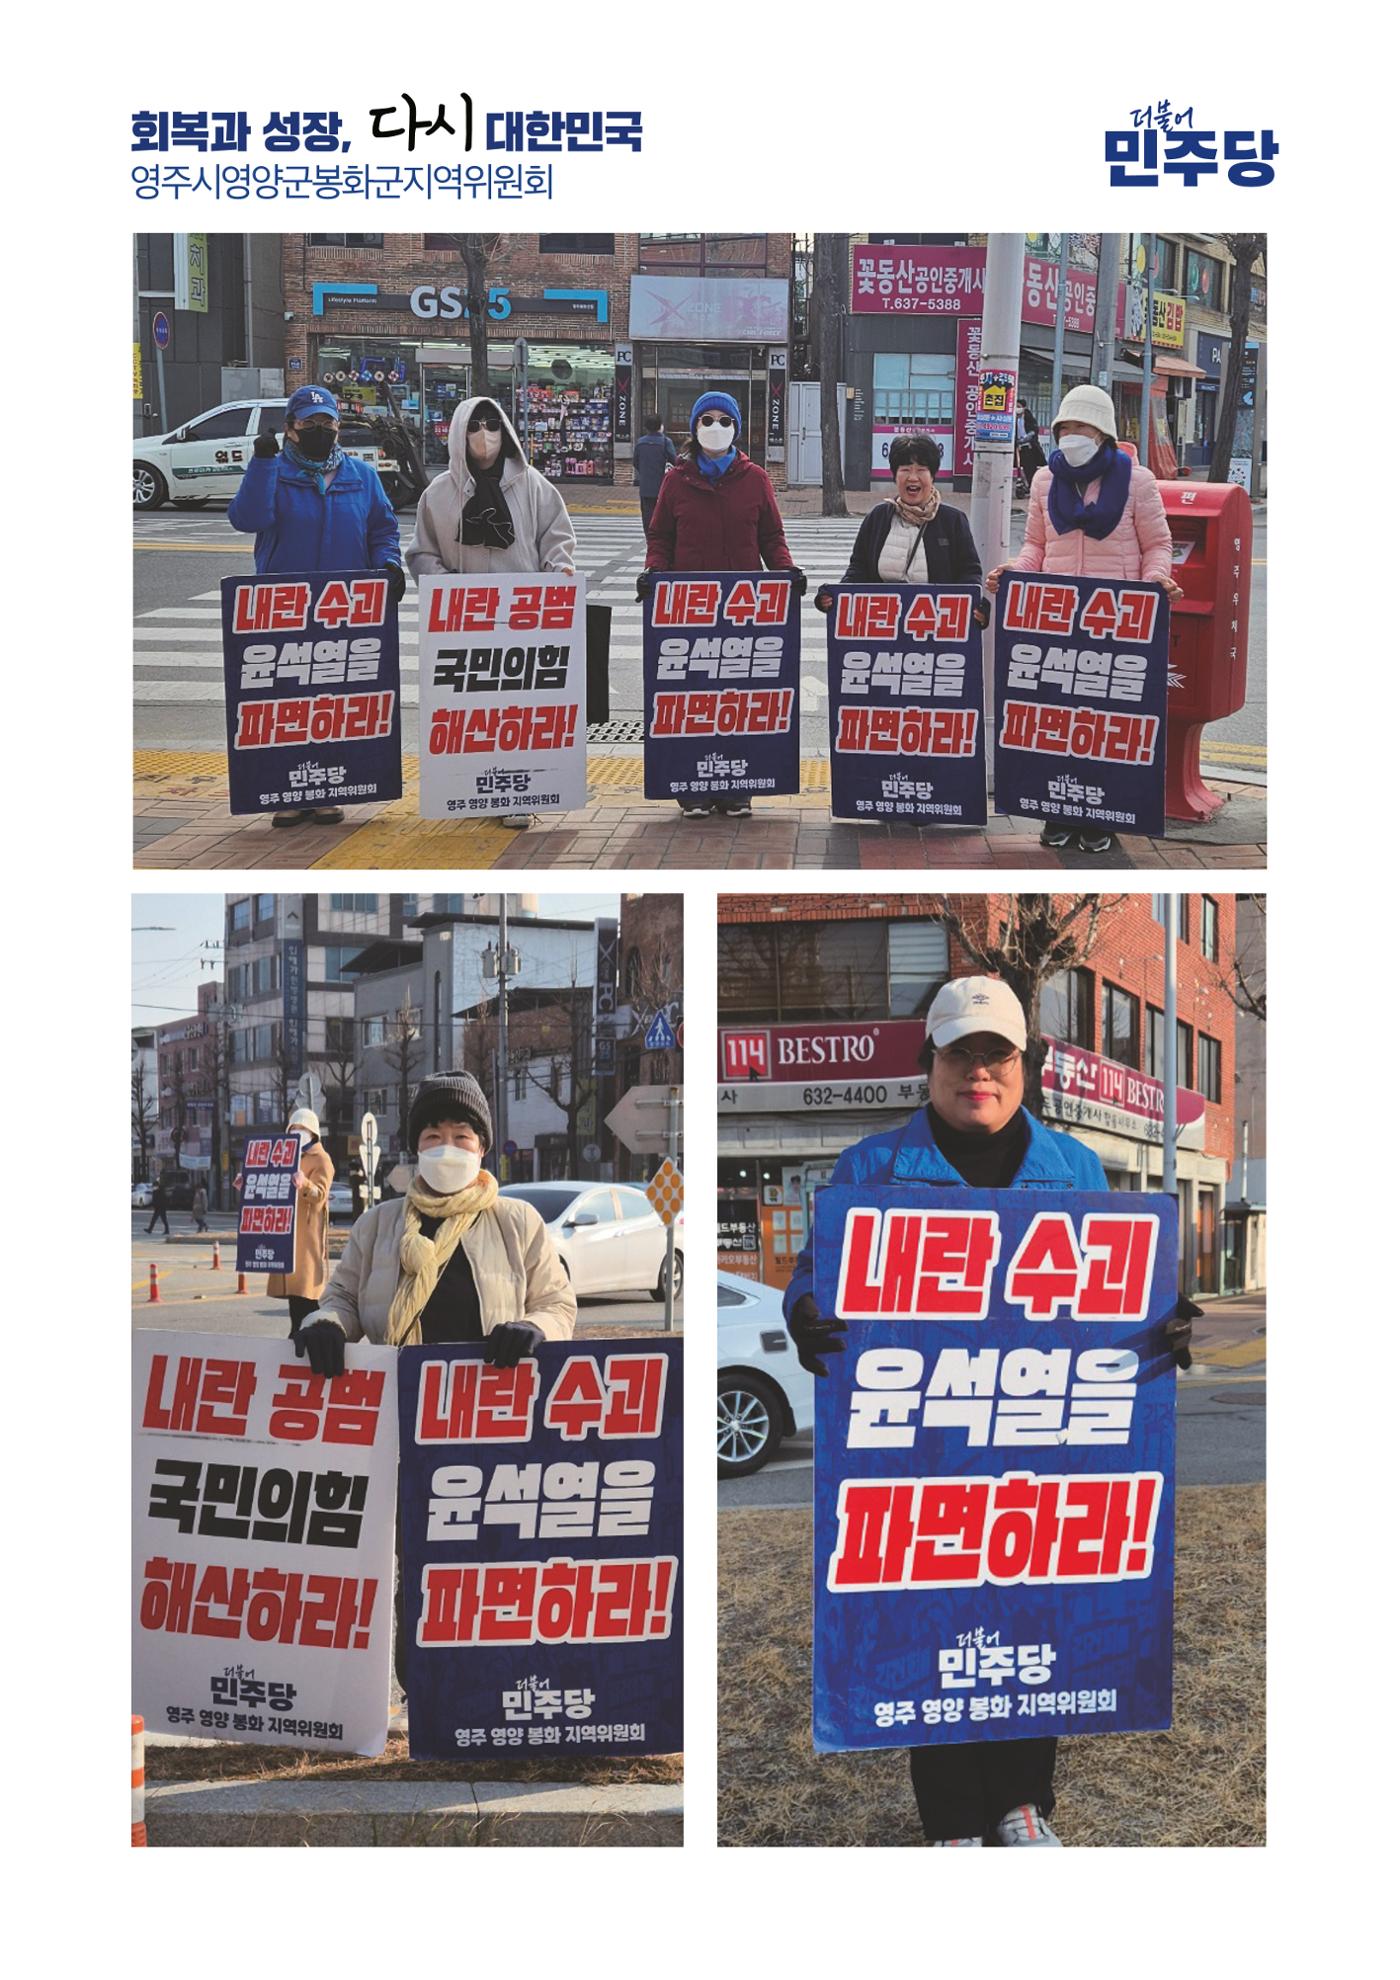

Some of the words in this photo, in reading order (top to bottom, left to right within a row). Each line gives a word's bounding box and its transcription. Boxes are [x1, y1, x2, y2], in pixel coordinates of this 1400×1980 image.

[410, 285, 512, 320] GS5
[882, 298, 961, 311] T.637-5388
[617, 351, 631, 362] PC
[771, 354, 785, 366] PC
[772, 399, 781, 430] ZONE
[236, 583, 308, 632] 내란
[314, 581, 385, 626] 수괴
[427, 587, 500, 632] 내란
[507, 585, 577, 631] 공범
[654, 582, 720, 625] 내란
[726, 582, 790, 624] 수괴
[837, 595, 902, 639] 내란
[904, 595, 972, 641] 수괴
[1005, 582, 1078, 634] 내란
[1081, 590, 1157, 641] 수괴
[240, 638, 382, 689] 윤석열을
[433, 645, 570, 692] 국민의힘
[656, 636, 784, 680] 윤석열을
[841, 651, 966, 697] 윤석열을
[1007, 644, 1147, 701] 윤석열을
[237, 692, 393, 746] 파면하라!
[428, 704, 579, 755] 해산하라!
[652, 689, 794, 736] 파면하라!
[837, 707, 978, 755] 파면하라!
[1002, 701, 1159, 764] 파면하라!
[288, 766, 347, 787] 민주당
[475, 773, 531, 794] 민주당
[696, 758, 748, 778] 민주당
[881, 780, 933, 800] 민주당
[1048, 780, 1105, 805] 민주당
[727, 1039, 765, 1067] 114
[777, 1034, 876, 1065] BESTRO
[720, 1090, 738, 1105] 사
[803, 1085, 888, 1106] 632-4400
[1103, 1067, 1123, 1100] 114
[246, 1141, 271, 1167] 내란
[244, 1174, 291, 1199] 윤석열을
[241, 1206, 293, 1233] 파면하라!
[842, 1214, 998, 1313] 내란
[1009, 1215, 1154, 1316] 수괴
[143, 1354, 256, 1436] 내란
[269, 1363, 386, 1446] 공범
[420, 1361, 535, 1441] 내란
[548, 1358, 663, 1438] 수괴
[847, 1348, 1139, 1449] 윤석열을
[148, 1458, 370, 1549] 국민의힘
[427, 1460, 655, 1540] 윤석열을
[835, 1477, 1158, 1585] 파면하라!
[139, 1556, 378, 1649] 해산하라!
[422, 1560, 673, 1643] 파면하라!
[956, 1627, 1001, 1649] 더불어
[224, 1665, 255, 1679] 더불어
[516, 1676, 549, 1691] 더불어
[938, 1644, 1056, 1690] 민주당
[211, 1676, 297, 1711] 민주당
[502, 1687, 595, 1721] 민주당
[874, 1701, 915, 1728] 영주
[922, 1699, 964, 1725] 영양
[970, 1696, 1012, 1720] 봉화
[1017, 1689, 1117, 1716] 지역위원회
[166, 1705, 195, 1725] 영주
[200, 1708, 228, 1729] 영양
[232, 1711, 264, 1733] 봉화
[268, 1716, 343, 1740] 지역위원회
[455, 1727, 487, 1747] 영주
[490, 1727, 523, 1746] 영양
[528, 1726, 560, 1745] 봉화
[565, 1723, 646, 1744] 지역위원회
